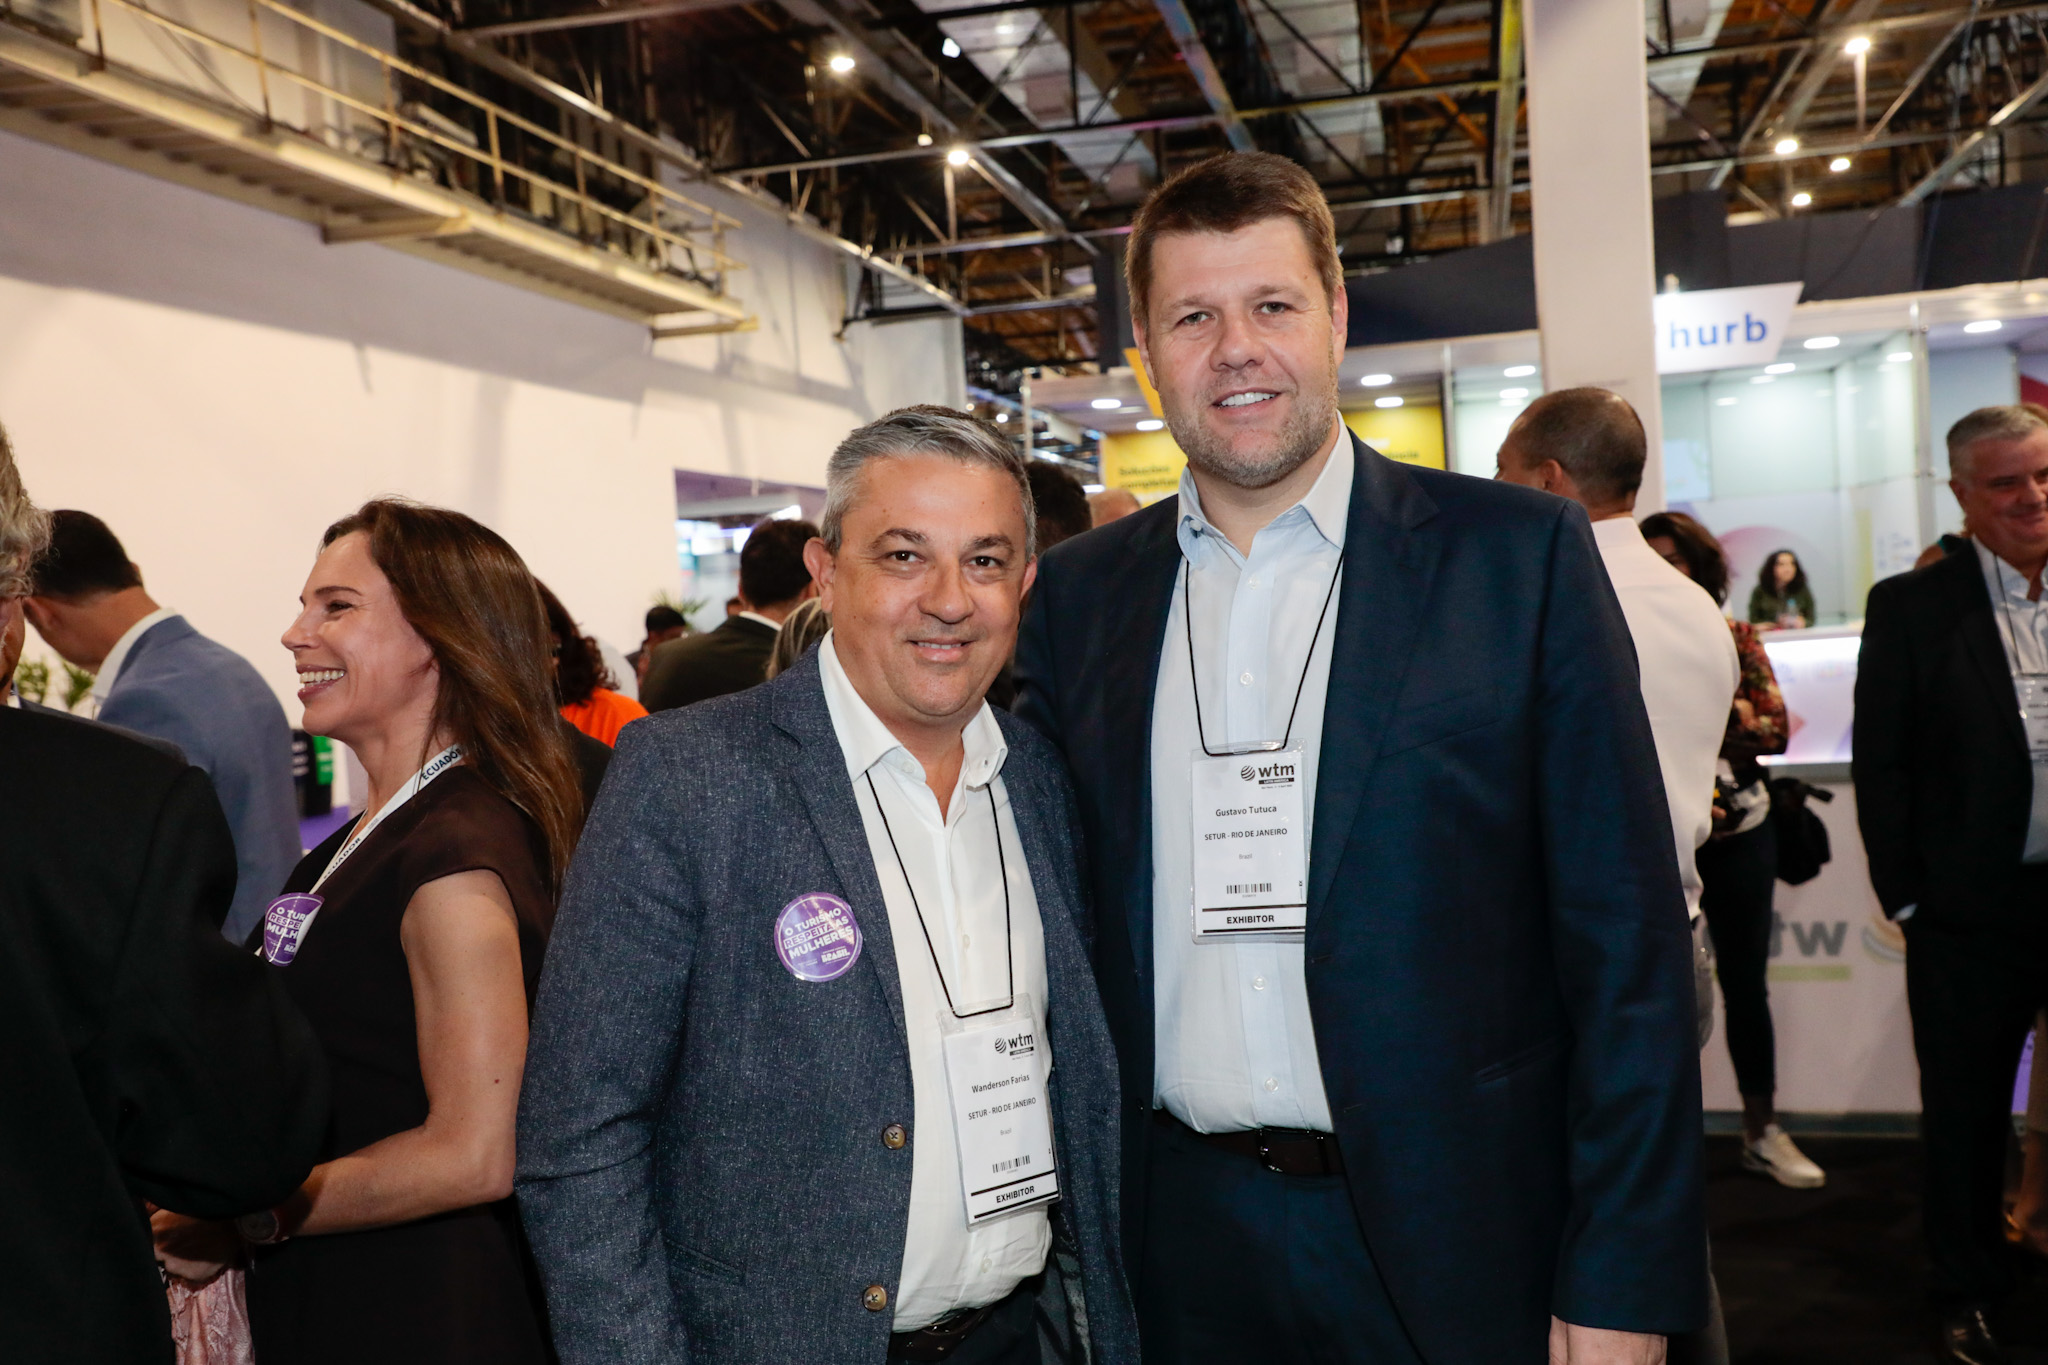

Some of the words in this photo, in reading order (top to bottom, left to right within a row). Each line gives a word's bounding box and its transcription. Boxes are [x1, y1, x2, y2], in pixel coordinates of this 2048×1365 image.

[1670, 313, 1767, 348] hurb
[1258, 763, 1294, 777] wtm
[1216, 808, 1247, 817] Gustavo
[1249, 806, 1277, 814] Tutuca
[1205, 833, 1226, 841] SETUR
[1256, 828, 1287, 837] JANEIRO
[276, 907, 286, 915] O
[1227, 915, 1274, 924] EXHIBITOR
[784, 927, 794, 936] O
[795, 908, 842, 932] TURISMO
[783, 922, 835, 949] RESPEITA
[836, 916, 849, 926] AS
[788, 925, 854, 959] MULHERES
[1008, 1033, 1033, 1048] wtm
[972, 1079, 1010, 1093] Wanderson
[1011, 1074, 1030, 1085] Farias
[968, 1110, 987, 1120] SETUR
[992, 1106, 1003, 1114] RIO
[1013, 1097, 1036, 1110] JANEIRO
[996, 1185, 1035, 1203] EXHIBITOR
